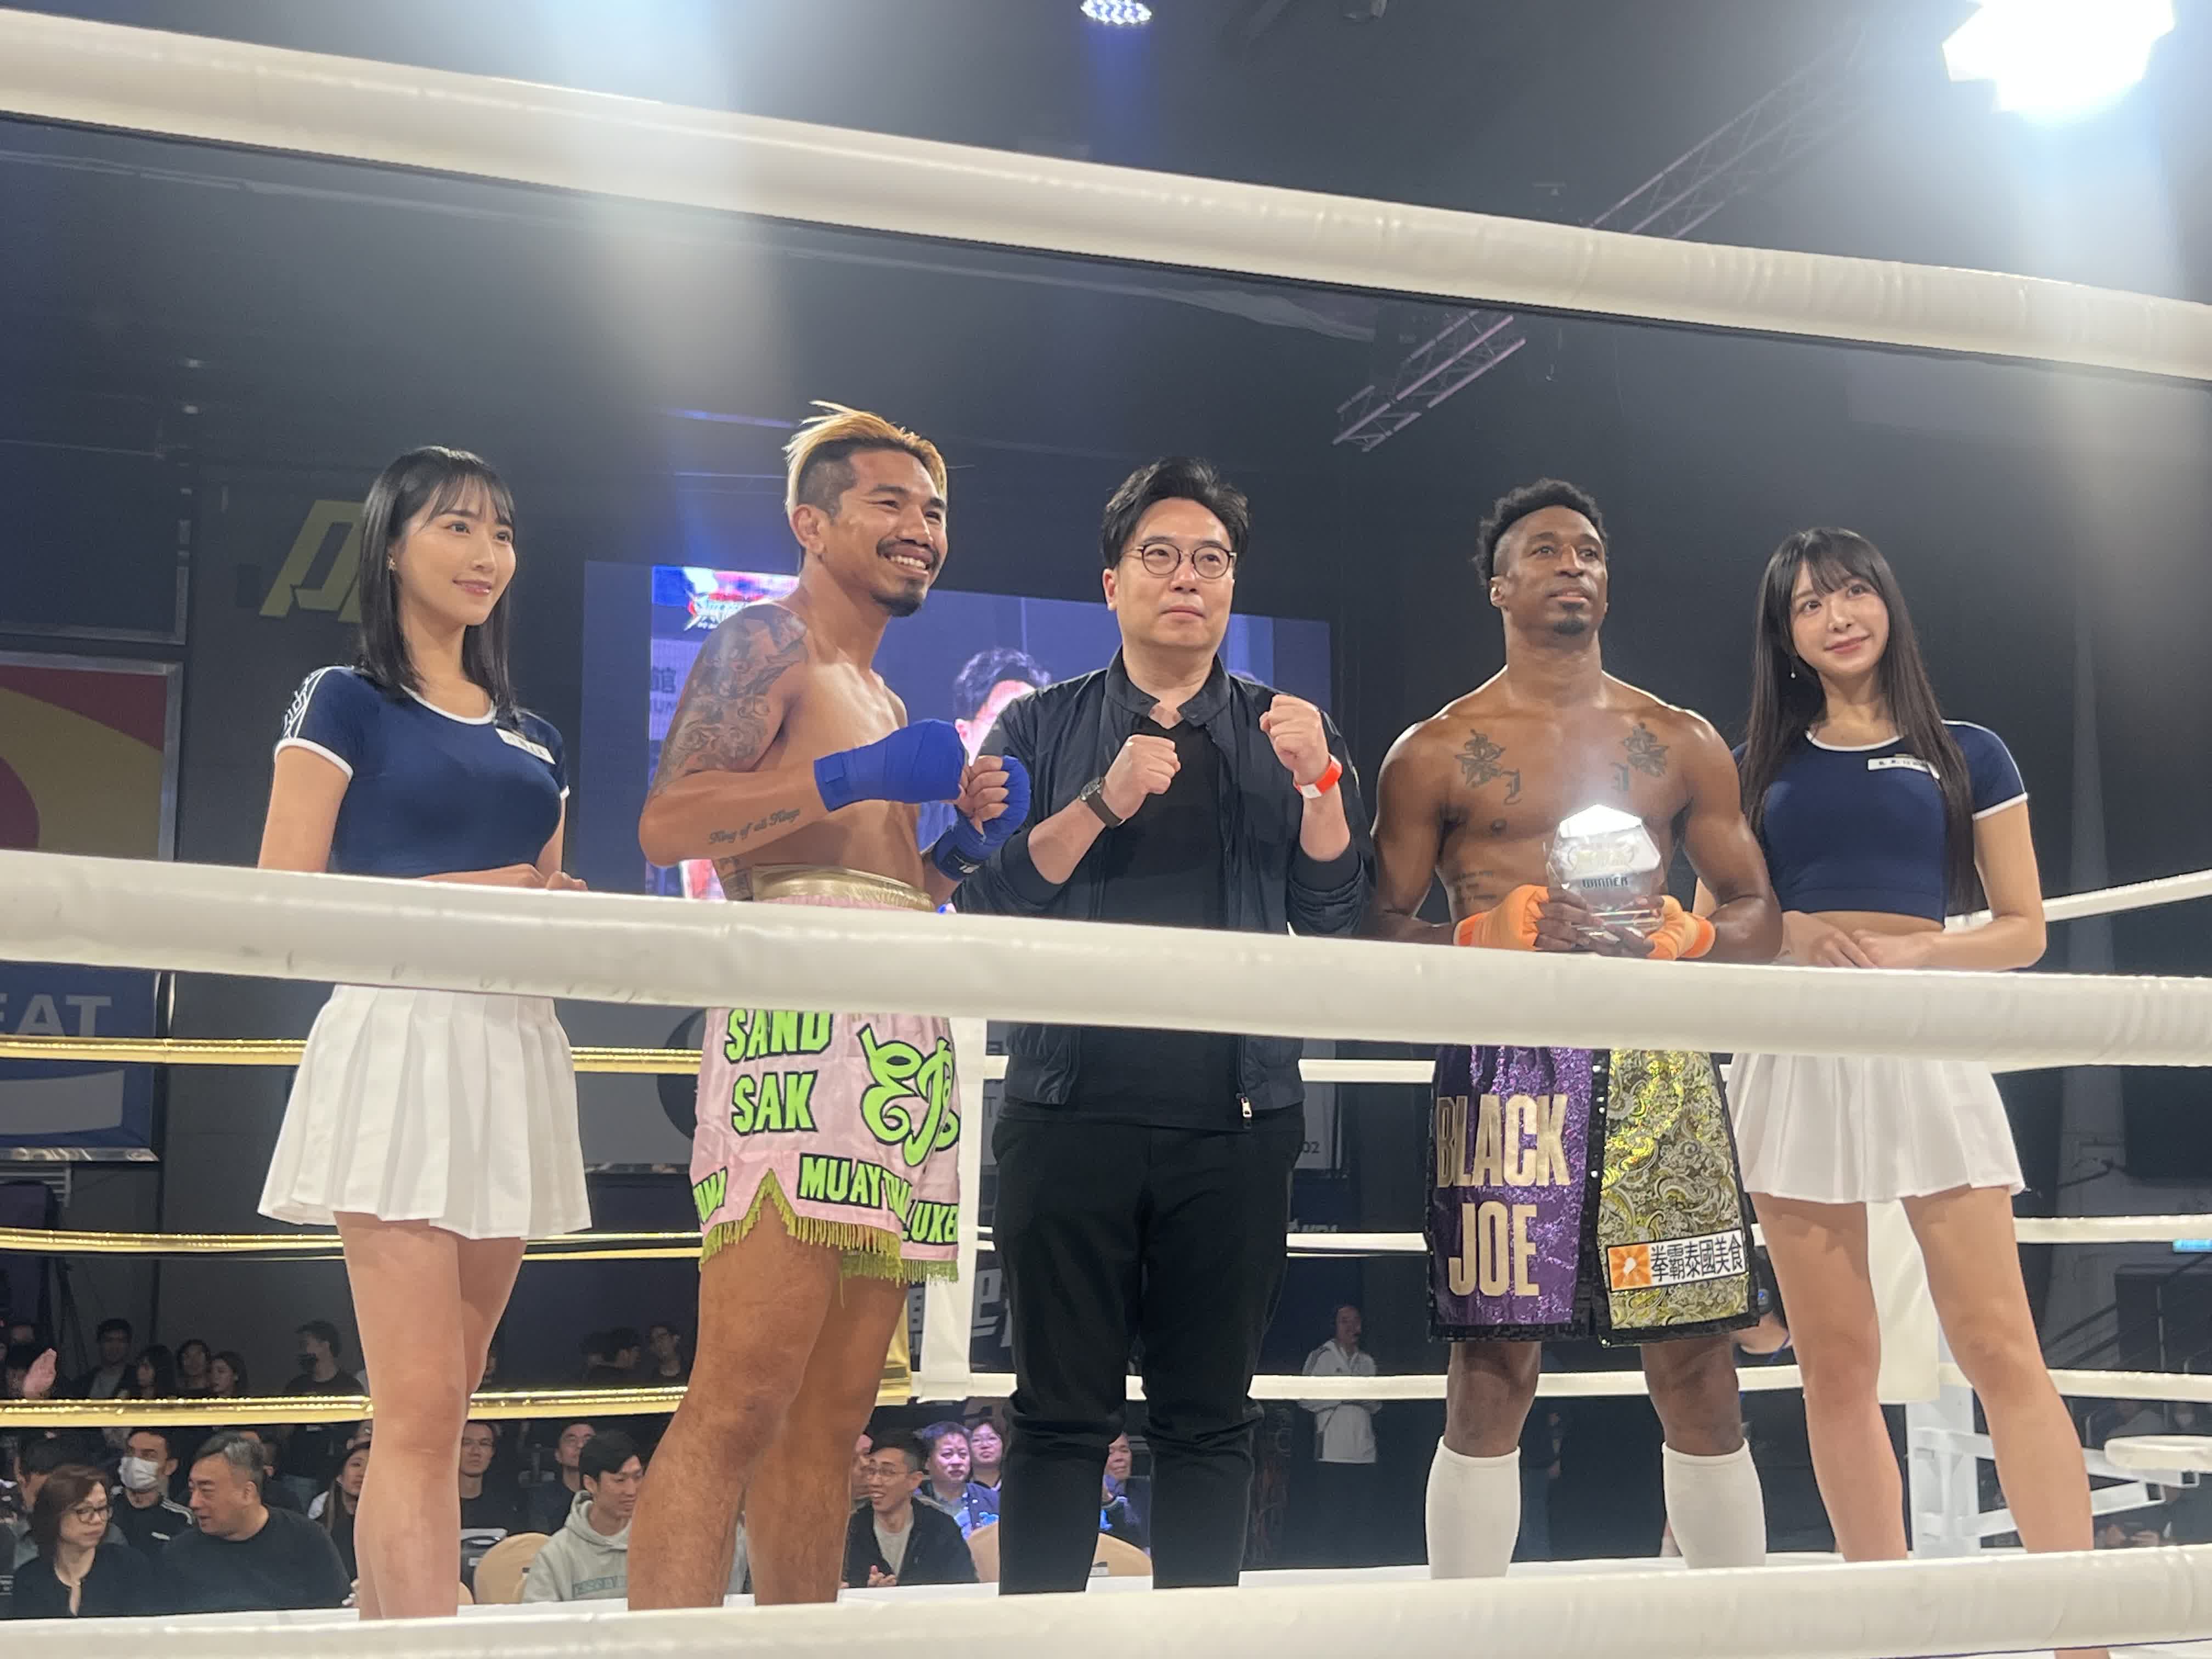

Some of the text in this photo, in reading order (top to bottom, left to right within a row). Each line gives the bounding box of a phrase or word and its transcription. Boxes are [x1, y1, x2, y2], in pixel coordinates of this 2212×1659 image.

[0, 993, 112, 1037] AT
[731, 1070, 820, 1136] SAK
[1436, 1094, 1571, 1188] BLACK
[1448, 1201, 1540, 1297] JOE
[1651, 1234, 1743, 1282] 拳霸泰國美食
